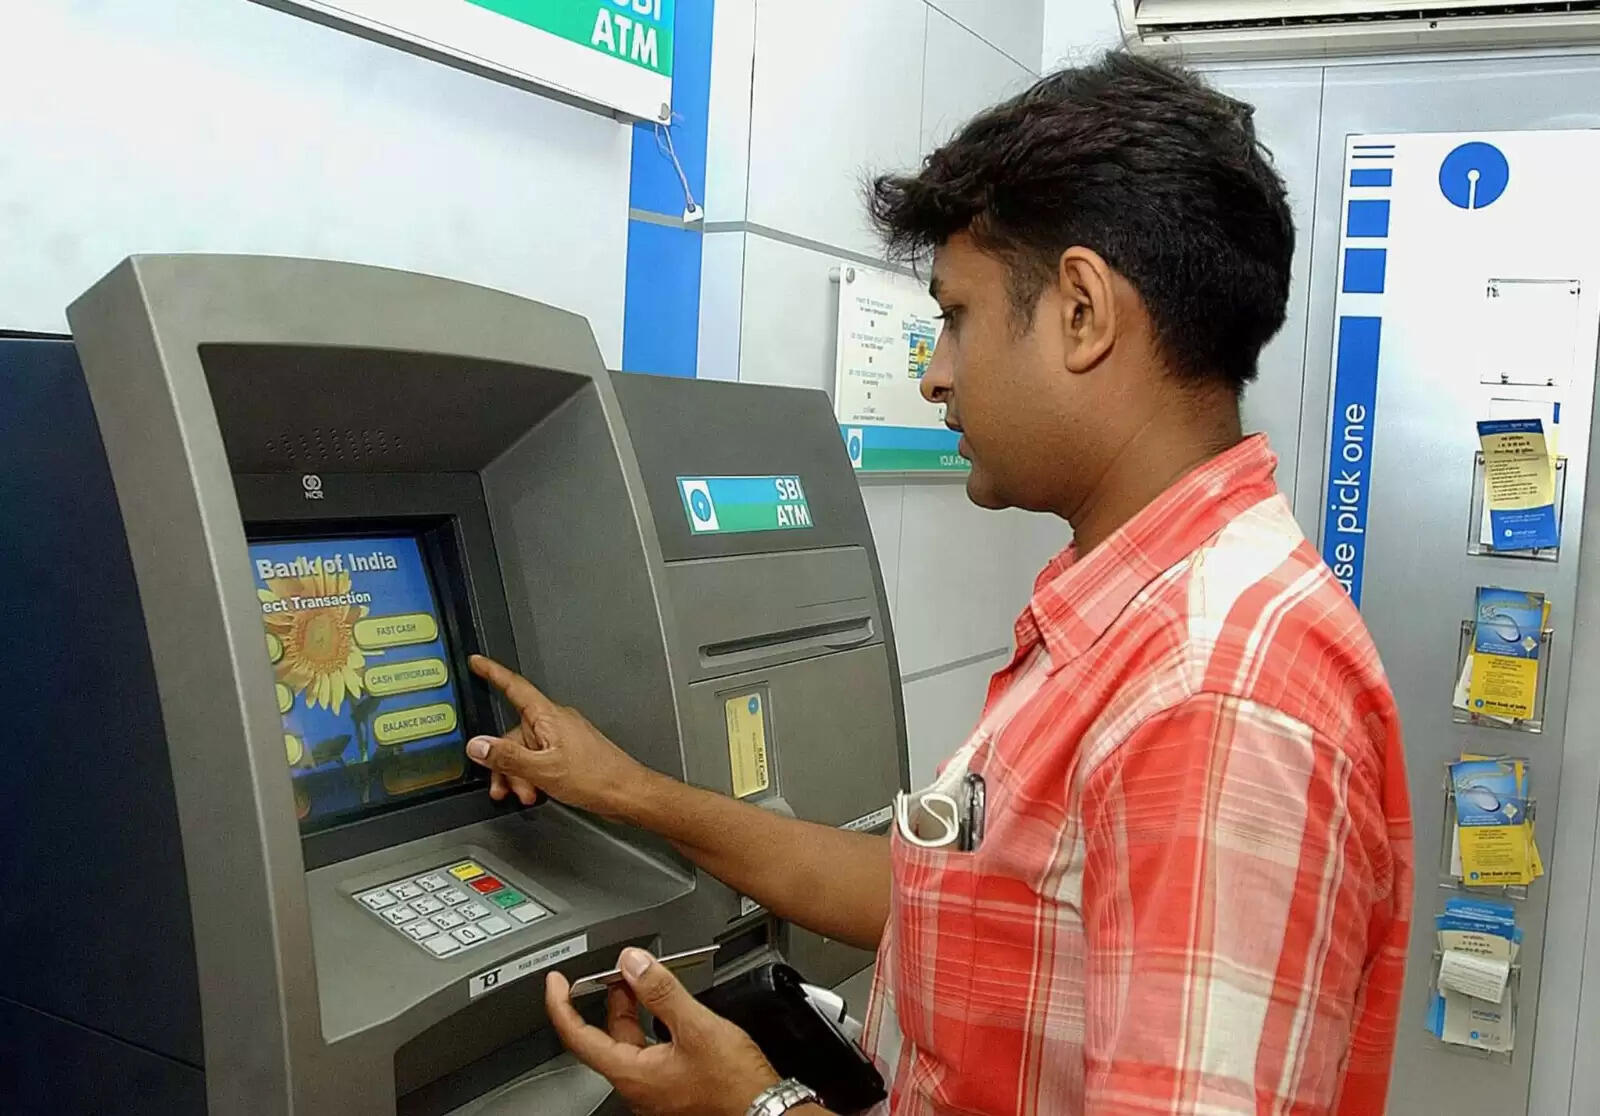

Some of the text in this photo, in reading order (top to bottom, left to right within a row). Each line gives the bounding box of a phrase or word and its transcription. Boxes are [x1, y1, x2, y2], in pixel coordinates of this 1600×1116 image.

[591, 7, 658, 68] ATM
[1342, 403, 1366, 462] one
[305, 490, 324, 499] NCR
[775, 479, 804, 501] SBI
[1331, 470, 1364, 533] pick
[776, 504, 810, 526] ATM
[256, 552, 398, 579] Bank of India
[293, 591, 371, 611] Transaction
[376, 624, 416, 636] FAST CASH
[371, 674, 393, 685] CASH
[382, 713, 447, 733] BALANCE INQUIRY
[396, 888, 409, 899] 2
[416, 903, 430, 913] 5
[461, 929, 476, 939] 0
